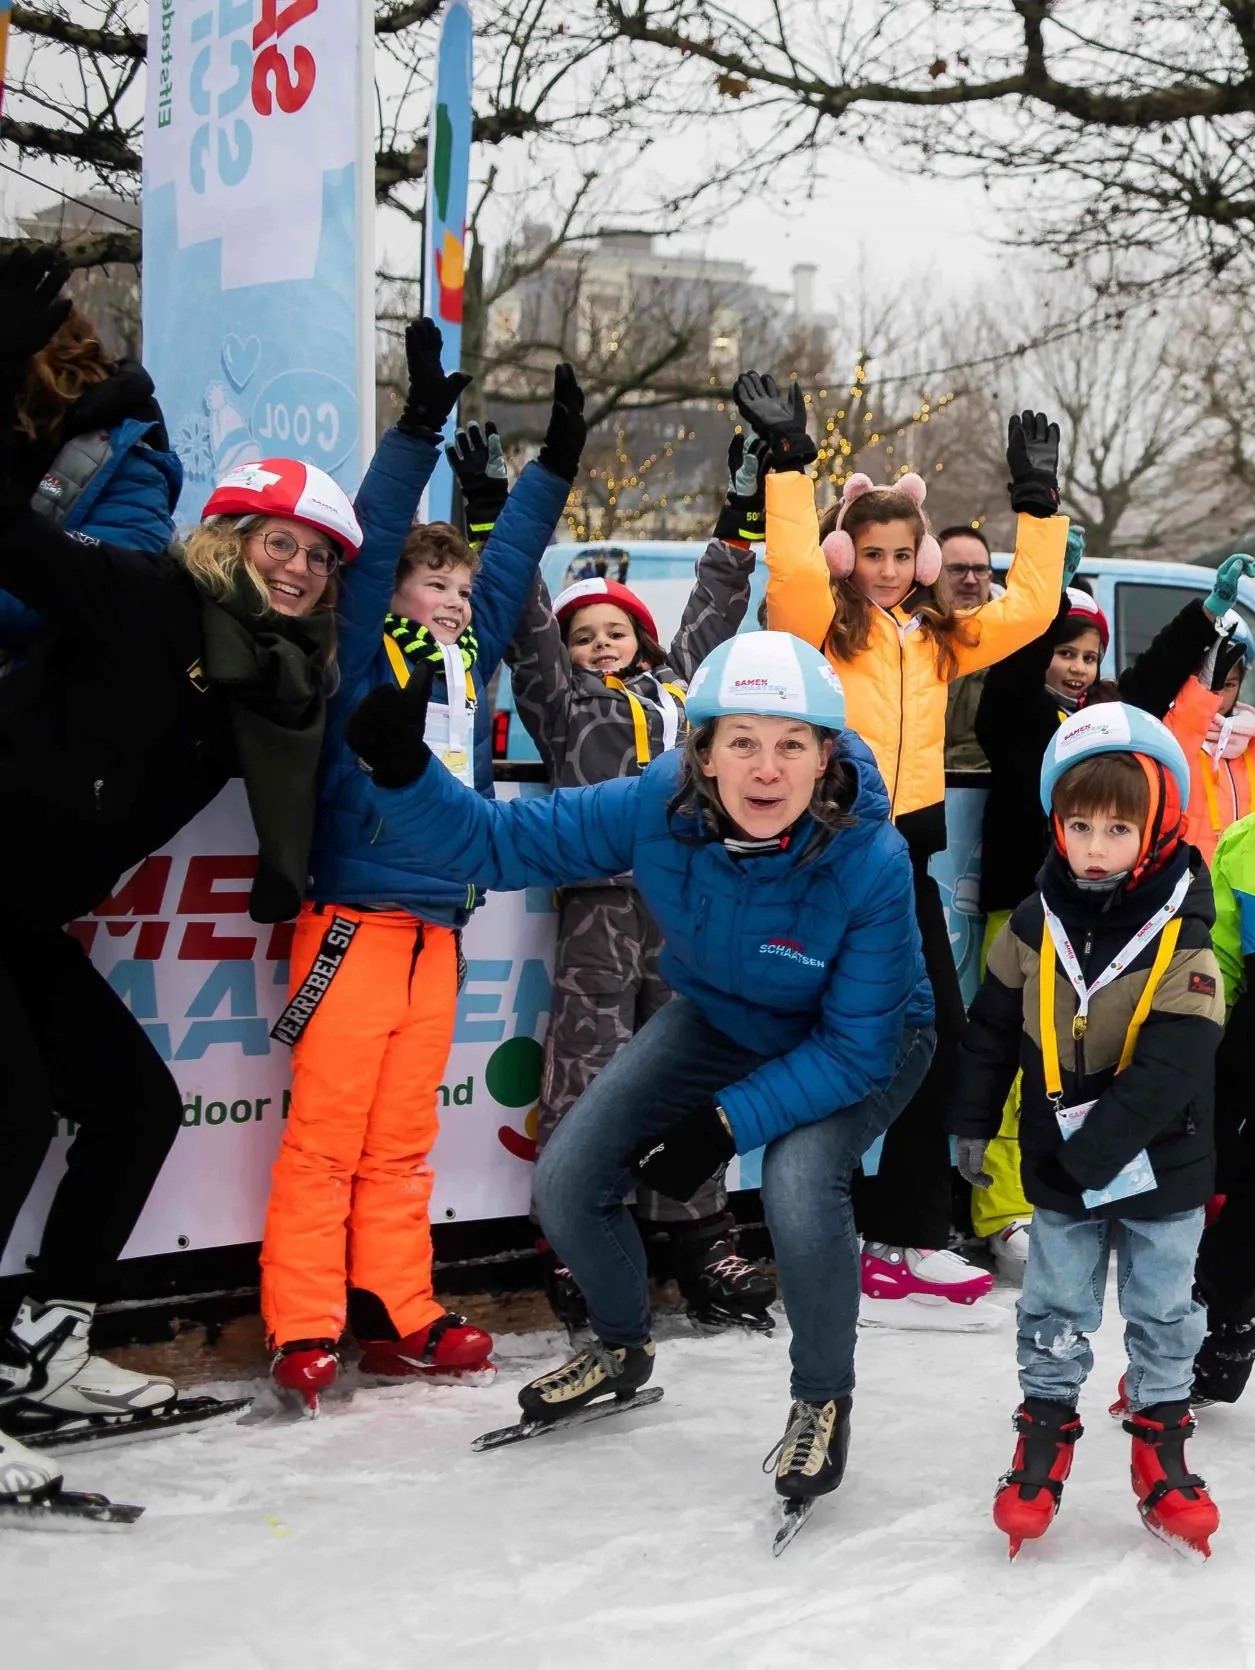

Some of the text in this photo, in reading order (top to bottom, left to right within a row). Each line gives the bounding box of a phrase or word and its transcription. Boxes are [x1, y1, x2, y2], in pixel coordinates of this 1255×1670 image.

[735, 678, 768, 687] SAMEN
[759, 944, 825, 968] SCHAATSEN
[180, 1096, 272, 1127] door
